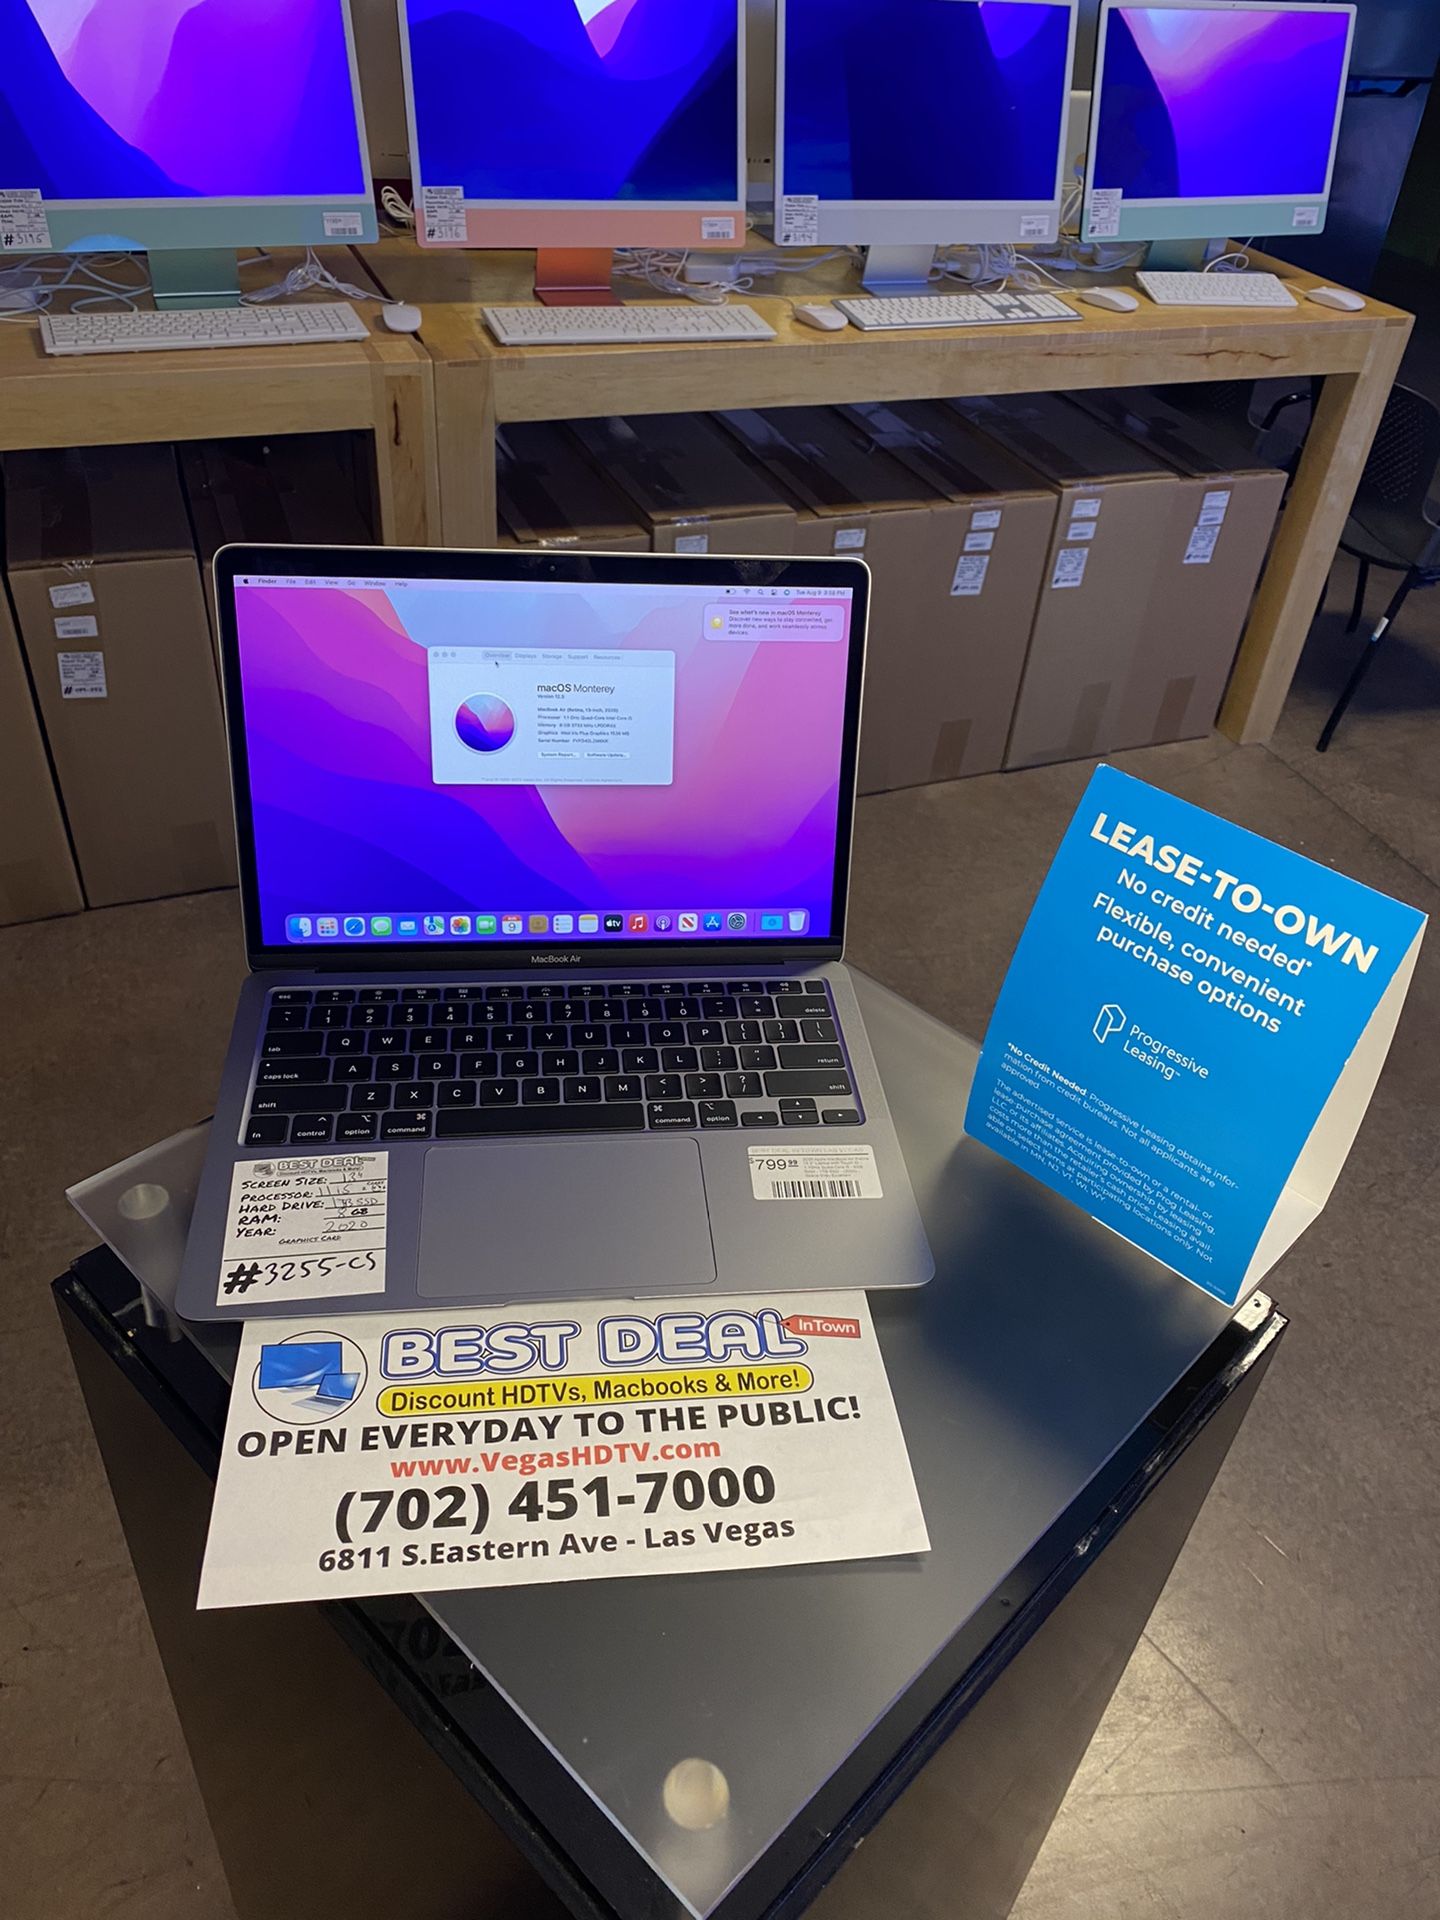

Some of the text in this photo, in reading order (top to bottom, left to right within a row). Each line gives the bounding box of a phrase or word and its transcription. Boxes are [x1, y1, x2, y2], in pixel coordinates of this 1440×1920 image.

[537, 683, 615, 695] macOS Monterey
[1090, 812, 1379, 973] LEASE-TO-OWN
[1116, 868, 1147, 895] No
[1151, 887, 1214, 931] credit
[531, 955, 581, 964] MacBook Air
[1092, 892, 1306, 1016] Flexible, convenient
[1096, 924, 1281, 1033] purchase options
[1130, 1024, 1209, 1079] Progressive
[1000, 1060, 1041, 1091] approved.
[297, 1129, 326, 1137] control
[344, 1128, 370, 1136] option
[387, 1126, 426, 1134] command
[1002, 1051, 1034, 1075] mation
[1034, 1070, 1056, 1089] from
[1055, 1084, 1082, 1105] credit
[1120, 1124, 1138, 1139] Not
[1138, 1135, 1150, 1147] all
[1149, 1143, 1200, 1178] applicants
[1199, 1174, 1216, 1188] are
[1023, 1052, 1051, 1074] Credit
[1088, 1092, 1140, 1130] Progressive
[1139, 1125, 1176, 1153] Leasing
[1175, 1147, 1213, 1174] obtains
[985, 1120, 1020, 1147] available
[1020, 1144, 1029, 1153] in
[992, 1087, 1054, 1130] lease-purchase
[1053, 1126, 1102, 1161] agreement
[1101, 1157, 1142, 1186] provided
[1141, 1182, 1155, 1195] by
[1154, 1190, 1177, 1210] Prog
[995, 1078, 1012, 1092] The
[1011, 1089, 1055, 1120] advertised
[1055, 1117, 1085, 1139] service
[1085, 1135, 1093, 1145] is
[1093, 1140, 1151, 1181] lease-to-own
[1151, 1177, 1162, 1188] or
[1162, 1185, 1169, 1193] a
[1201, 1209, 1213, 1220] or
[241, 1179, 291, 1190] SCREEN
[295, 1176, 328, 1186] SIZE:
[278, 1158, 318, 1170] BEST
[321, 1156, 364, 1167] DEAL
[989, 1104, 1009, 1121] costs
[1010, 1118, 1032, 1136] more
[1032, 1132, 1053, 1150] than
[1053, 1146, 1069, 1160] the
[1105, 1180, 1127, 1197] cash
[1152, 1210, 1188, 1238] Leasing
[1008, 1108, 1017, 1117] or
[1018, 1113, 1030, 1125] its
[1066, 1144, 1109, 1176] Acquiring
[1108, 1172, 1156, 1207] ownership
[1155, 1202, 1169, 1215] by
[1168, 1210, 1202, 1236] leasing
[239, 1203, 276, 1214] HARD
[282, 1200, 325, 1211] DRIVE:
[241, 1191, 313, 1202] PROCESSOR:
[987, 1112, 1004, 1127] able
[1004, 1124, 1017, 1135] on
[1017, 1132, 1041, 1151] select
[1041, 1148, 1066, 1167] items
[1065, 1164, 1076, 1174] at
[1075, 1171, 1131, 1210] participating
[1131, 1207, 1173, 1237] locations
[1195, 1248, 1214, 1264] Not
[236, 1221, 368, 1238] YEAR: 2020
[238, 1214, 281, 1225] RAM:
[278, 1237, 317, 1245] GRAPHICS
[223, 1252, 376, 1295] #3255-CS
[380, 1308, 808, 1380] BEST DEAL
[798, 1318, 857, 1335] InTown
[391, 1369, 801, 1411] Discount HDTVs, Macbooks & More!
[237, 1396, 861, 1458] OPEN EVERYDAY TO THE PUBLIC!
[390, 1440, 721, 1478] www.VegasHDTV.com
[335, 1465, 776, 1544] (702) 451-7000
[318, 1545, 390, 1572] 6811
[401, 1538, 549, 1567] S.Eastern
[559, 1532, 617, 1555] Ave
[645, 1526, 696, 1548] Las
[703, 1519, 796, 1547] Vegas
